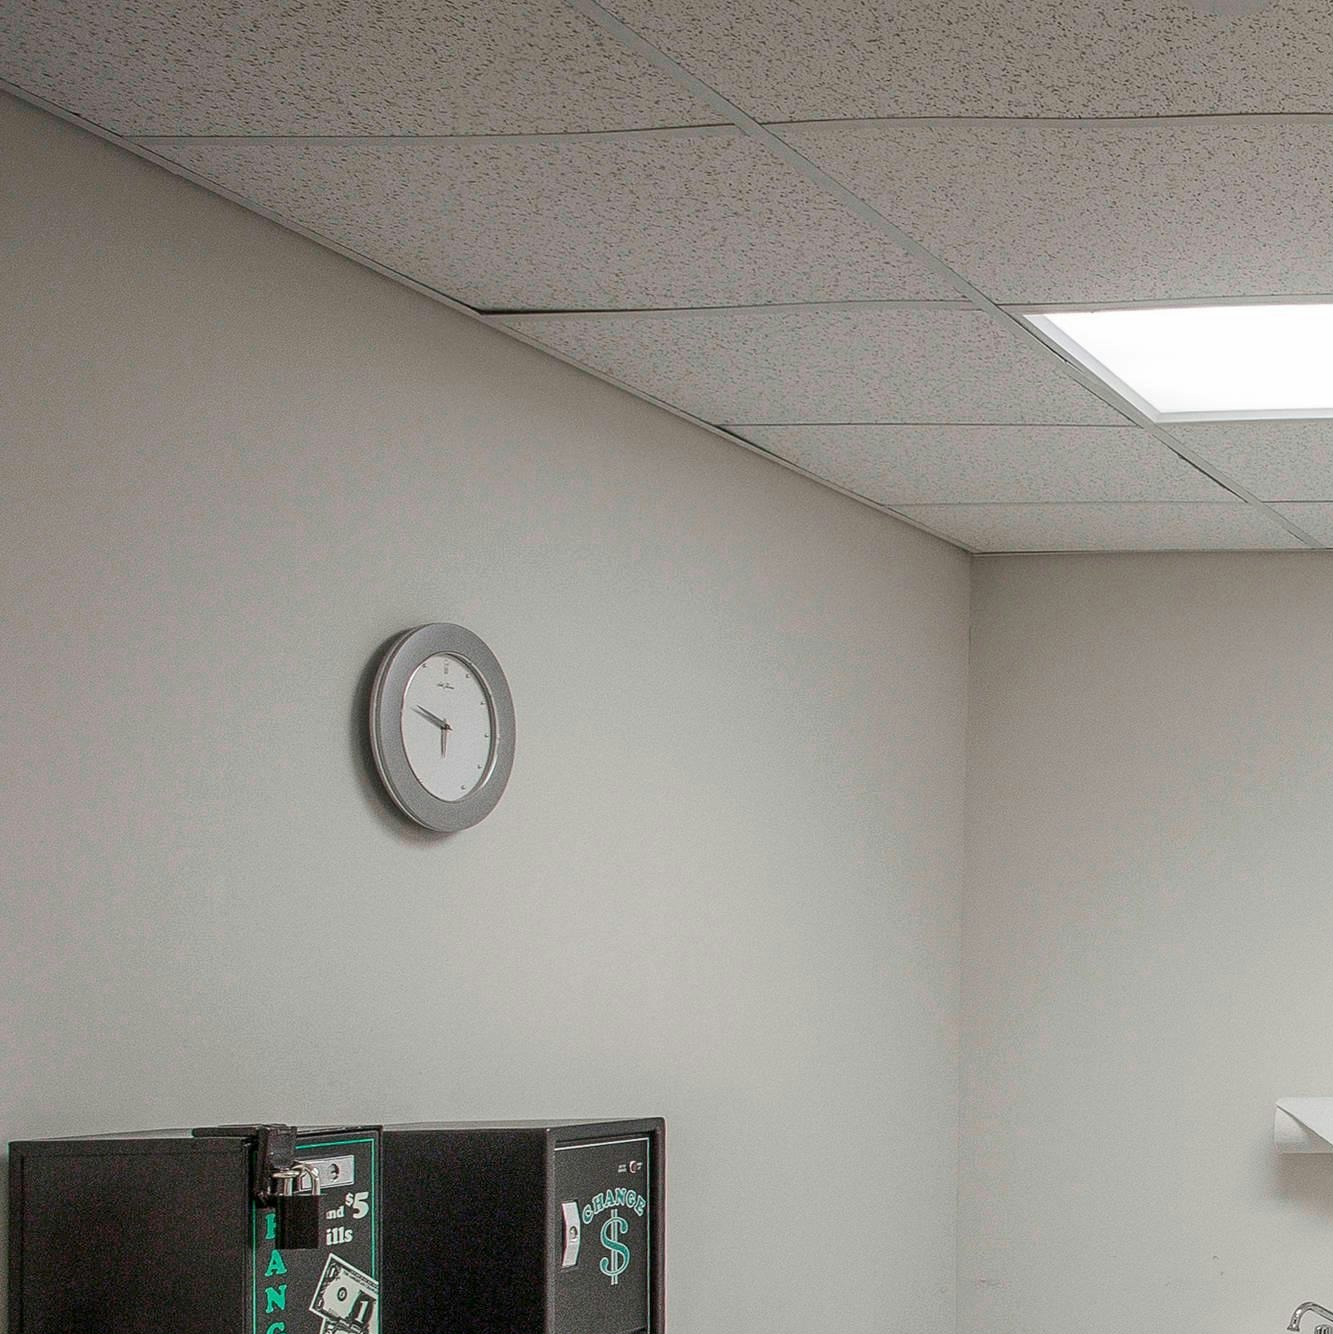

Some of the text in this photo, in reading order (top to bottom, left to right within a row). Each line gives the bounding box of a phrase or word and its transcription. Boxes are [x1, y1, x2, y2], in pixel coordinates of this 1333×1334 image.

[345, 1191, 370, 1220] $5
[582, 1187, 647, 1225] CHANGE
[326, 1226, 353, 1246] ills
